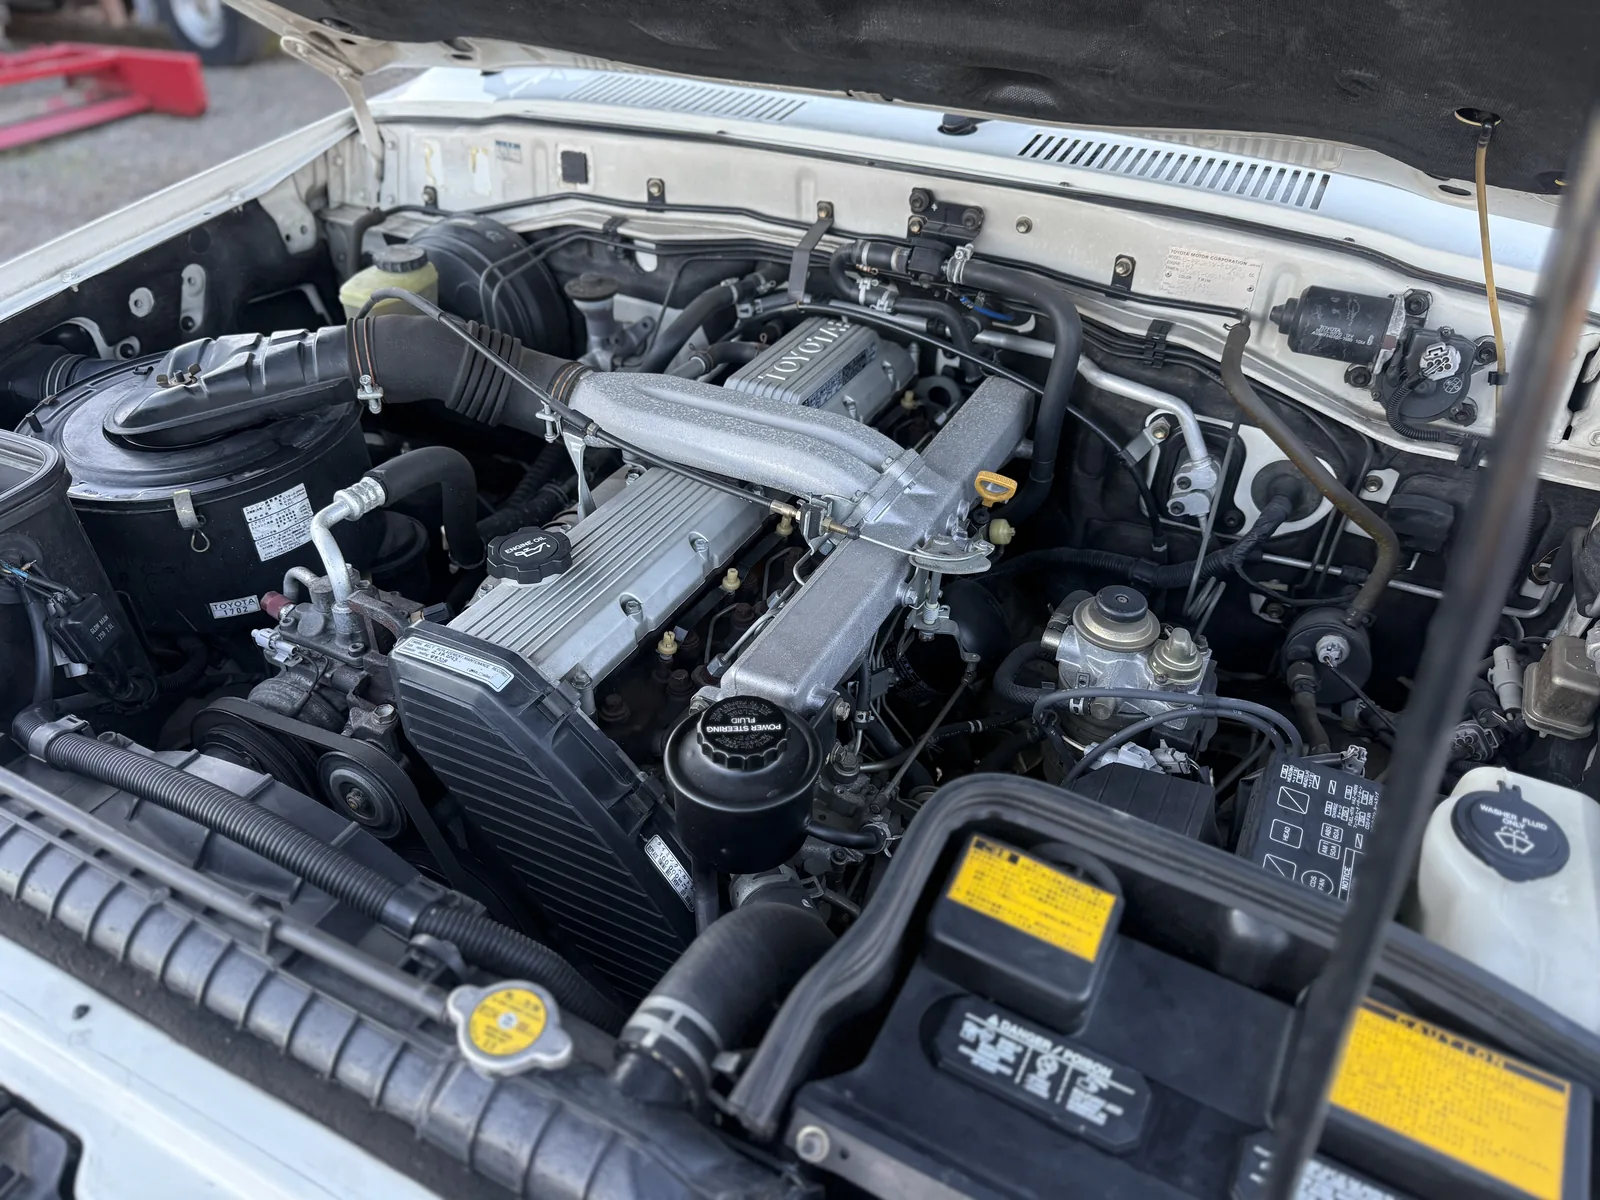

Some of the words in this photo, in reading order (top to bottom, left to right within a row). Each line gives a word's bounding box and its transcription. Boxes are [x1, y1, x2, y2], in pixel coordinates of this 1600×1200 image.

[1210, 255, 1248, 266] CORPORATION
[758, 321, 850, 380] TOYOTA
[504, 540, 533, 553] ENGINE
[213, 599, 256, 610] TOYOTA
[224, 606, 248, 615] 1702
[1480, 804, 1517, 820] WASHER
[1522, 817, 1548, 830] FLUID
[1502, 818, 1526, 829] ONLY
[1342, 867, 1351, 890] NOTICE
